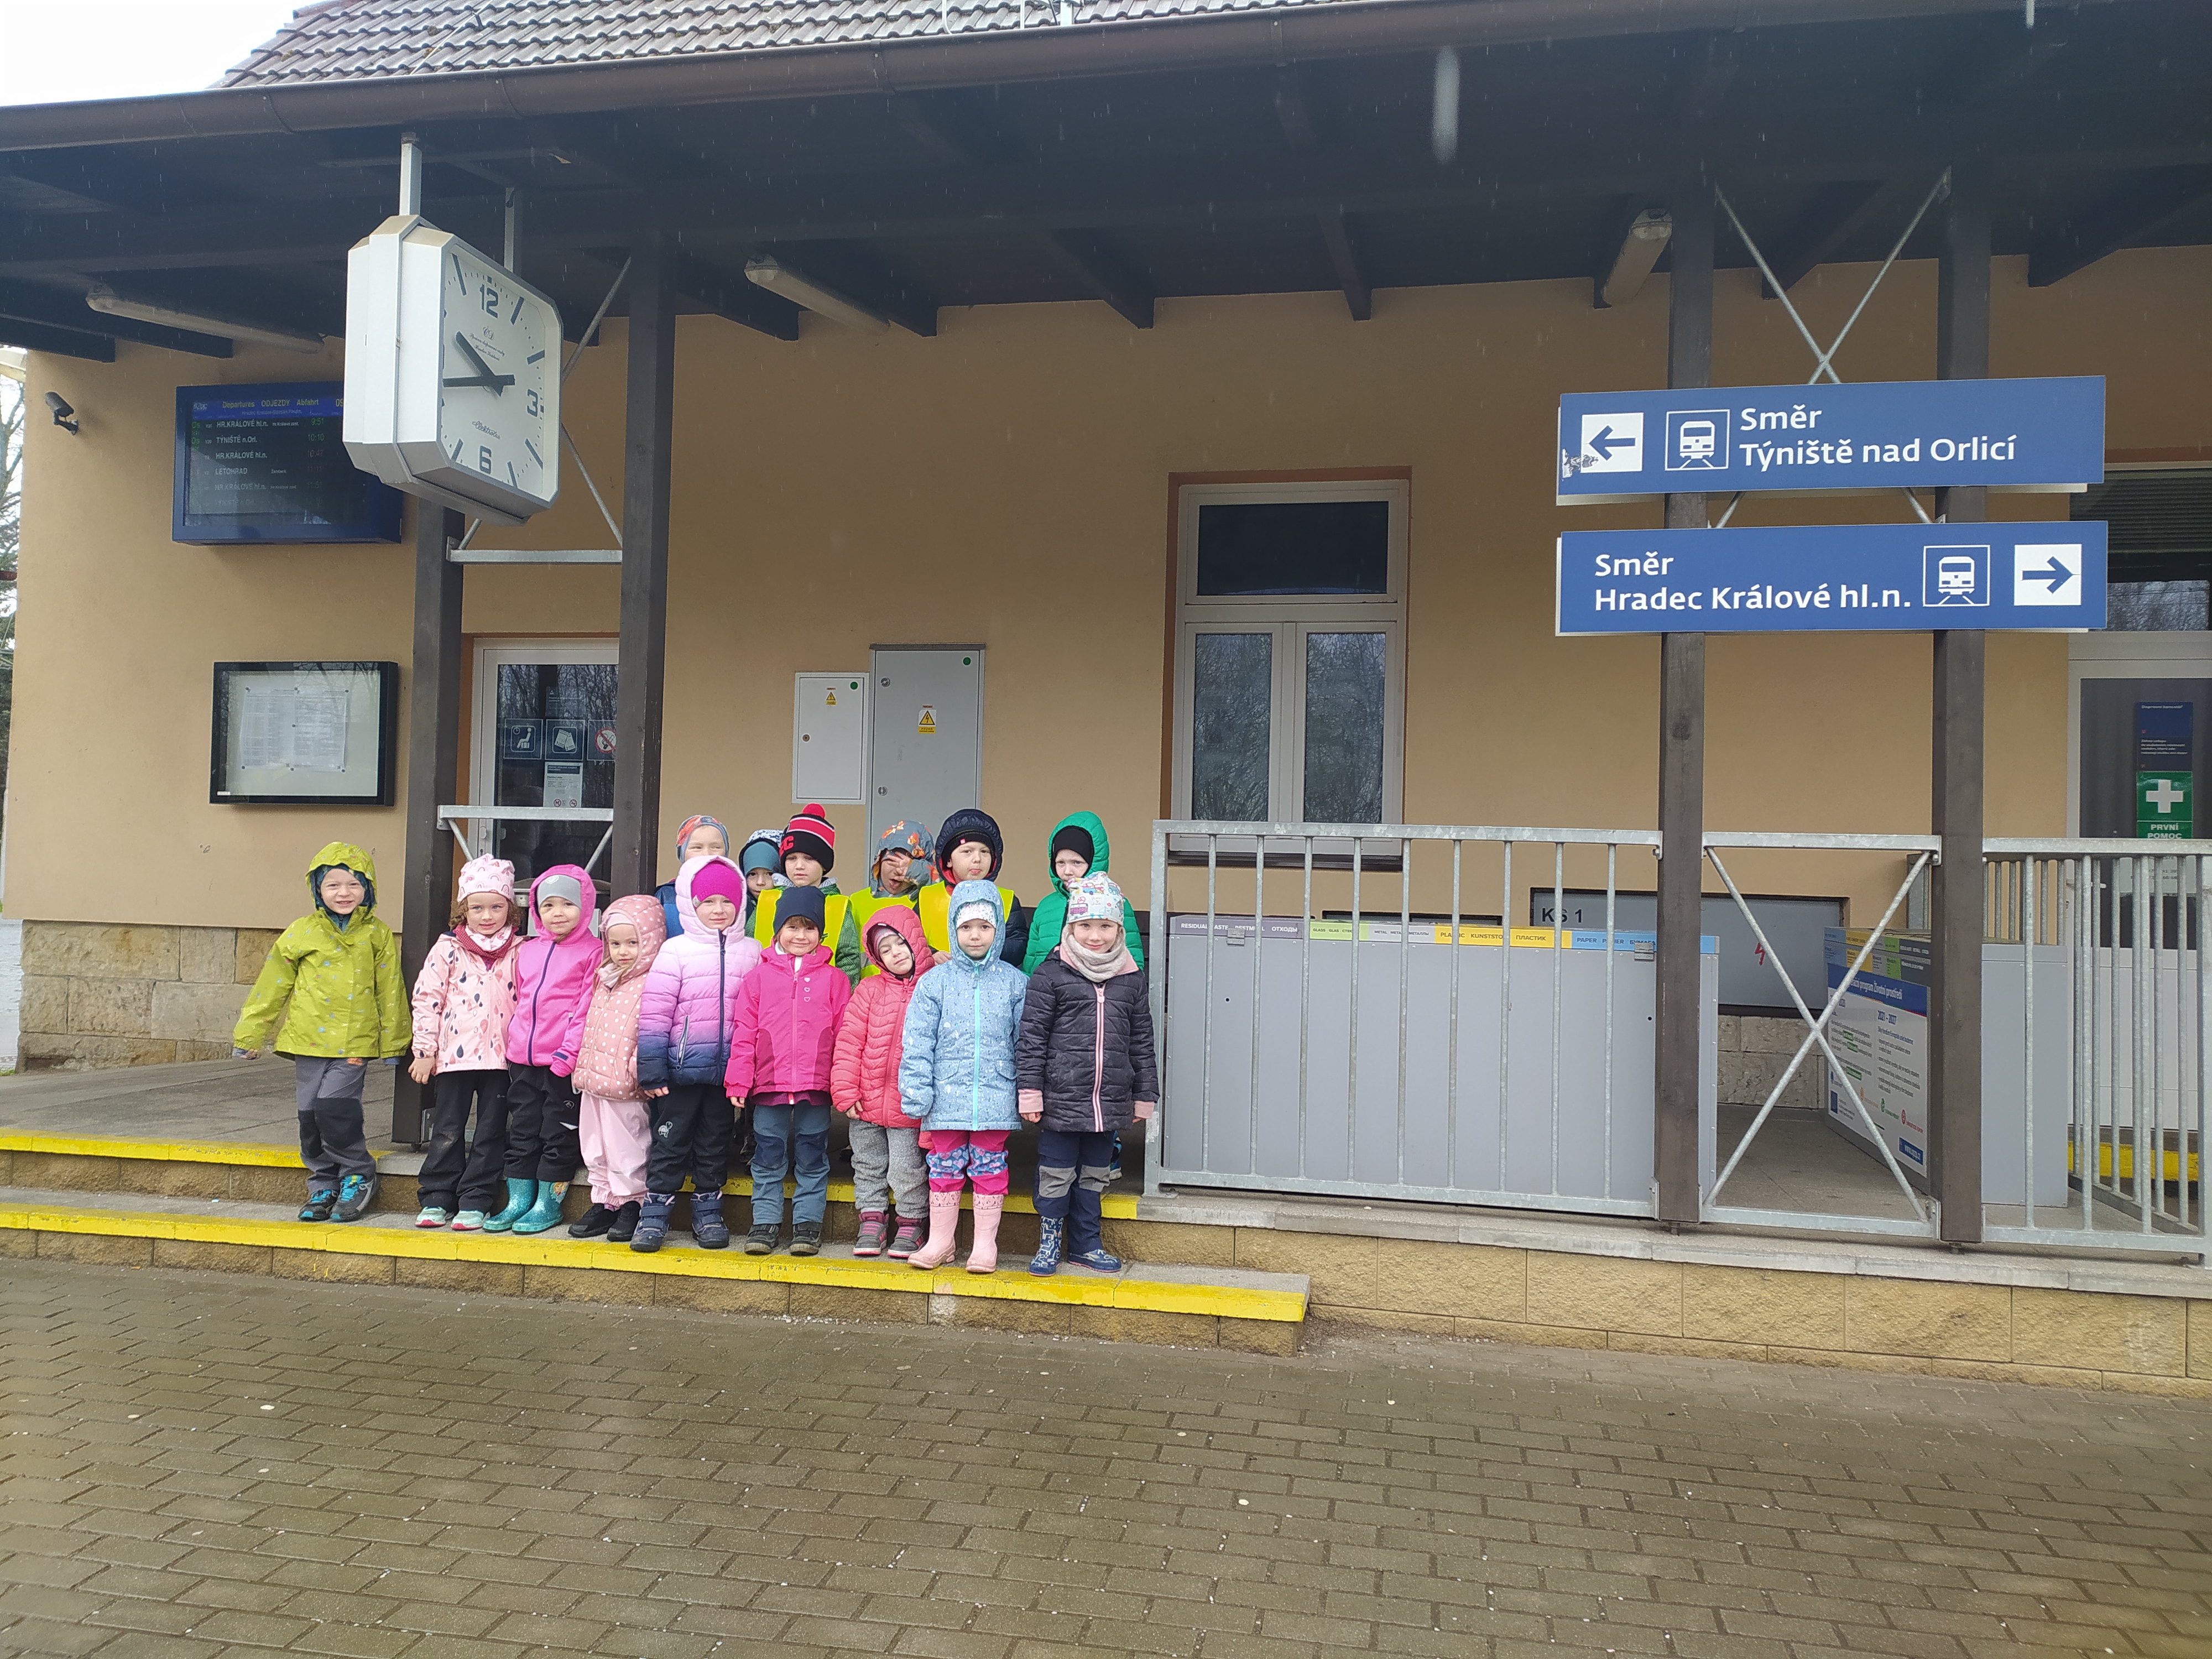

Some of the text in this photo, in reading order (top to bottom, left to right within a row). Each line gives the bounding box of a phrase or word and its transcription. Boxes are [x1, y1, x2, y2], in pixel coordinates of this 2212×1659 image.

[479, 284, 498, 319] 12
[527, 389, 538, 418] 3
[1740, 404, 1822, 431] Směr
[308, 433, 325, 441] 10:10
[479, 445, 491, 474] 6
[1739, 434, 2017, 472] Týniště nad Orlicí
[215, 467, 248, 476] LETOHRAD
[1594, 551, 1674, 576] Směr
[1595, 583, 1911, 611] Hradec Králové hl.n.
[1574, 909, 1583, 924] 1
